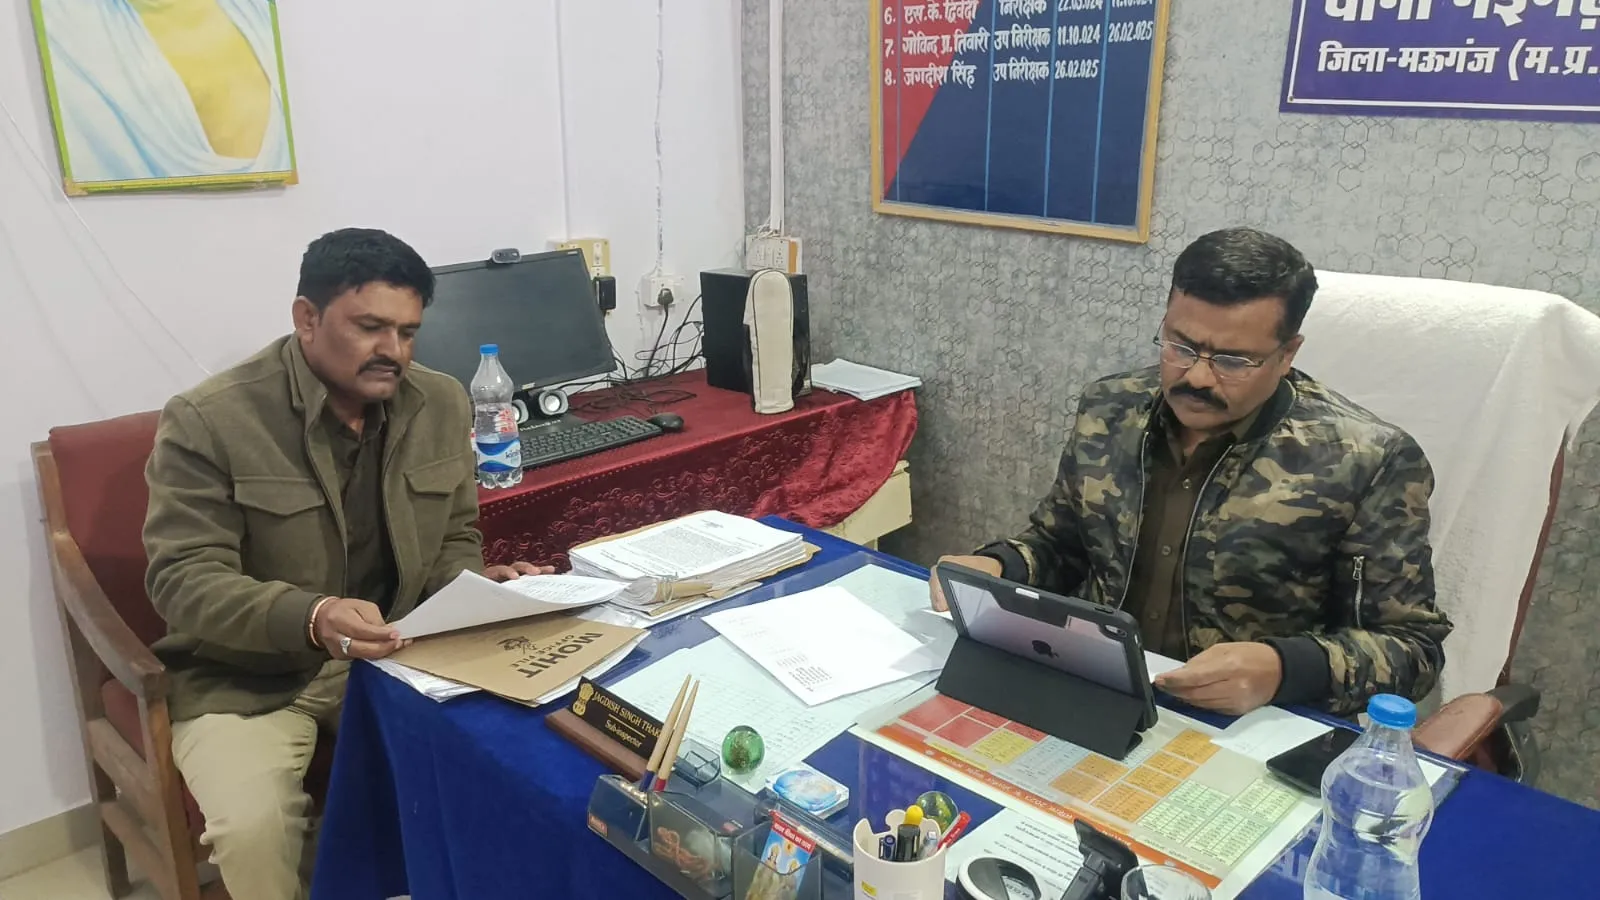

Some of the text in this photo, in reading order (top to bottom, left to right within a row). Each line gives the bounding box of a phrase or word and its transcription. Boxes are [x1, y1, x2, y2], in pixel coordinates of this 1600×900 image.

[953, 27, 991, 55] तिवारी
[994, 31, 1009, 50] उप
[1010, 24, 1051, 52] निरीक्षक
[1057, 24, 1101, 46] 11.10.024
[1108, 20, 1154, 43] 26.02.025
[1317, 38, 1500, 72] जिला-मऊगंज
[903, 62, 948, 88] जगदीश
[950, 60, 977, 88] सिंह
[993, 64, 1007, 81] उप
[1008, 57, 1050, 82] निरीक्षक
[1055, 59, 1099, 80] 26.02.025
[517, 632, 604, 679] MOHIT
[592, 691, 620, 714] JAGDISH
[619, 707, 642, 727] SINGH
